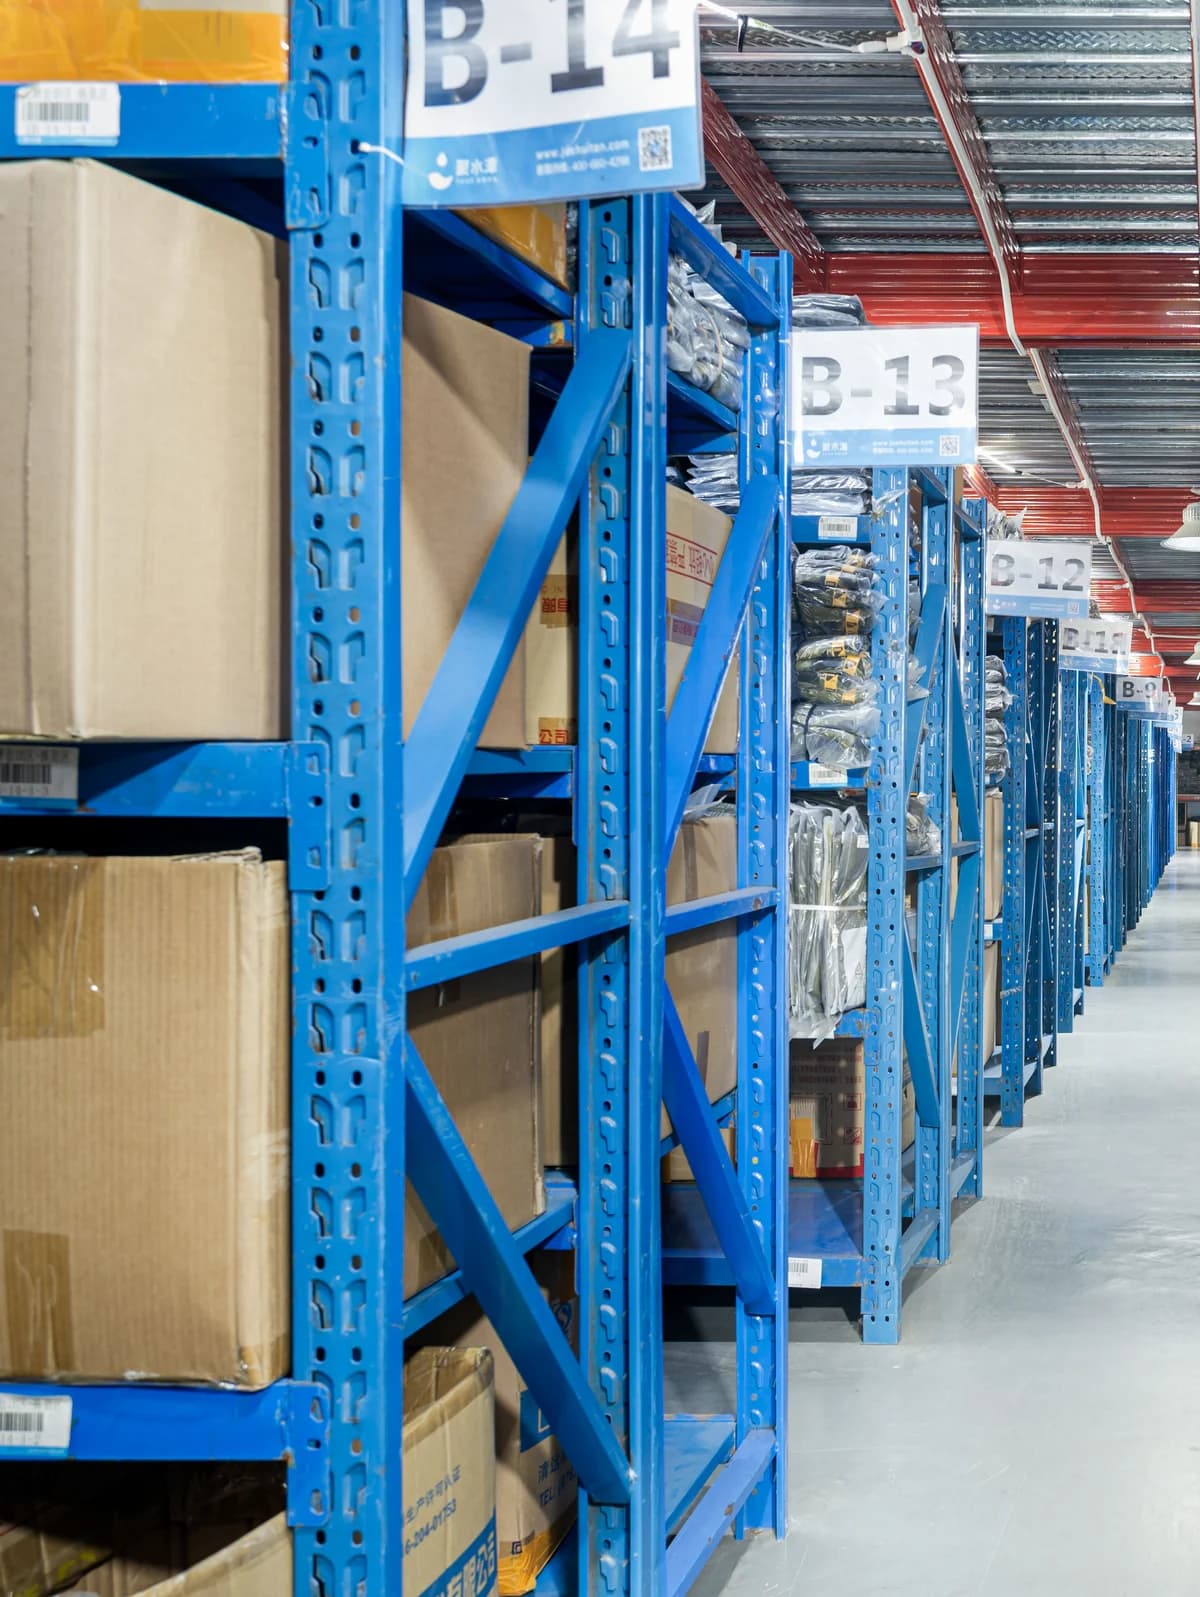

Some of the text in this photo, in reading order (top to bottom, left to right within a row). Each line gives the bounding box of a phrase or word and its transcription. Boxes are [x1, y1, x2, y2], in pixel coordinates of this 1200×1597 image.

[424, 0, 680, 107] B-14
[801, 354, 966, 416] B-13
[990, 553, 1085, 592] B-12
[539, 729, 568, 745] 公司
